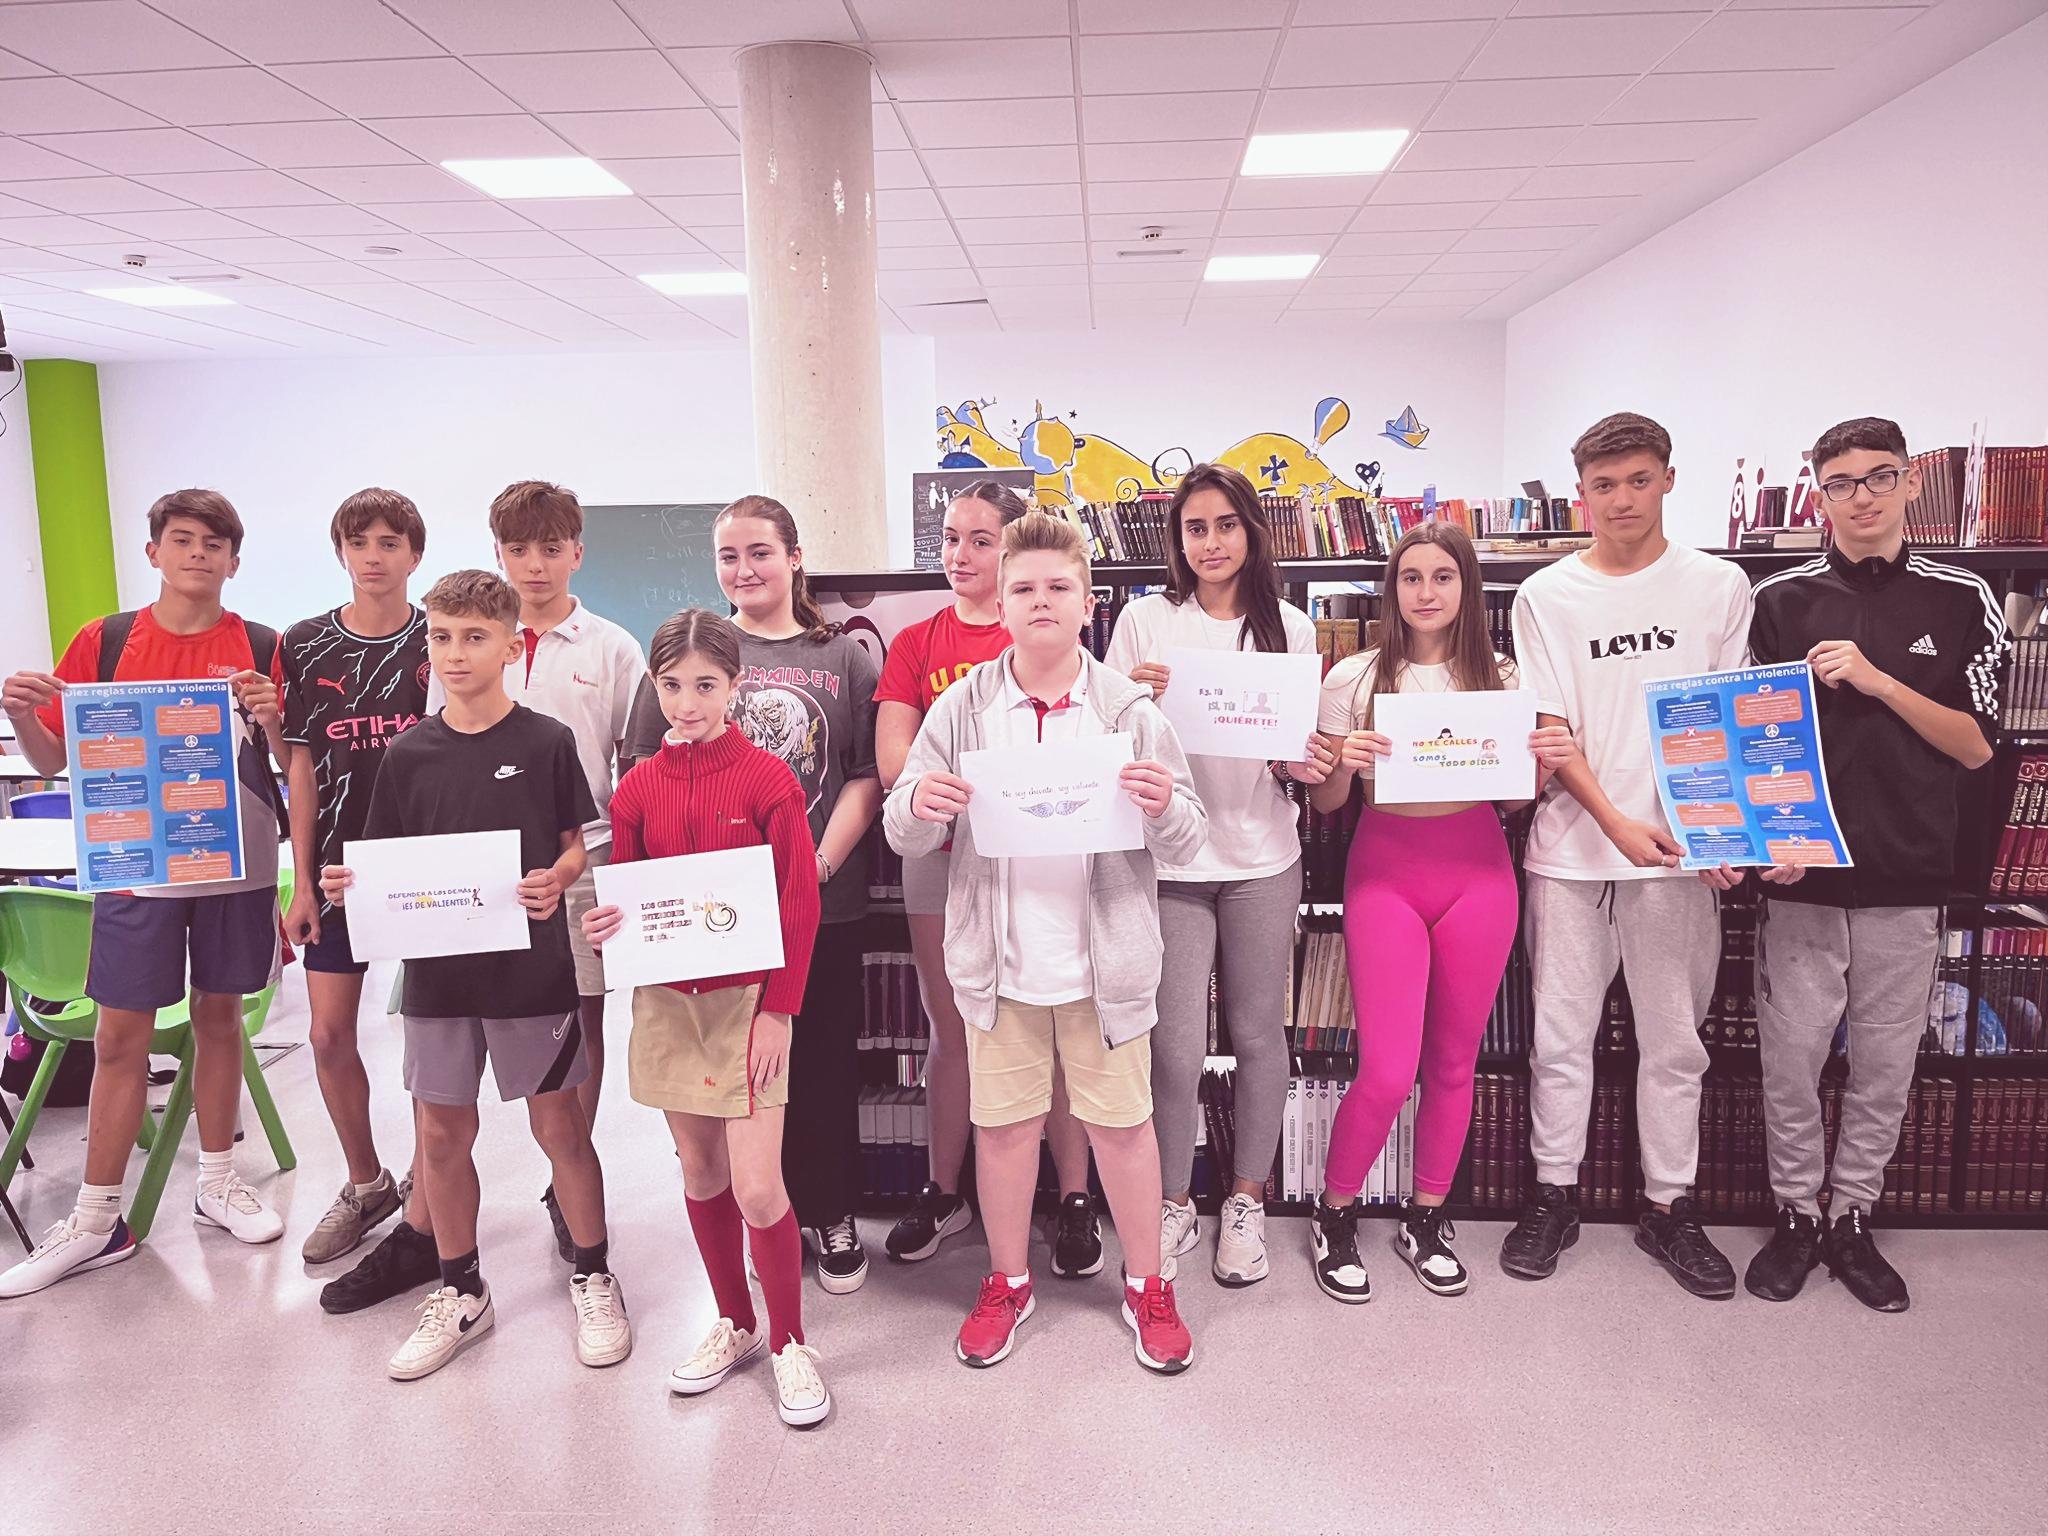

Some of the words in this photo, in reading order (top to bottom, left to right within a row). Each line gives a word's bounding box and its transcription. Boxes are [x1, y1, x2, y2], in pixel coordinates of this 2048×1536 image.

[1731, 480, 1743, 519] 8
[1794, 475, 1811, 516] 7
[1588, 625, 1677, 660] Levi's
[1908, 646, 1938, 656] adidas
[748, 665, 841, 700] MAIDEN
[1646, 683, 1669, 693] Diez
[1671, 679, 1703, 691] reglas
[1705, 674, 1741, 686] contra
[1743, 672, 1754, 681] la
[1756, 665, 1807, 679] violencia
[91, 686, 126, 698] reglas
[127, 686, 164, 695] contra
[166, 684, 177, 693] la
[179, 683, 228, 693] violencia
[325, 712, 420, 740] ETIHA
[350, 736, 393, 752] AIRW
[1412, 740, 1425, 748] NO
[1443, 738, 1478, 747] CALLES
[1412, 754, 1447, 762] SOMOS
[1439, 760, 1467, 768] TODO
[387, 890, 426, 900] DEFENDER
[434, 888, 447, 897] LOS
[415, 900, 425, 909] DE
[426, 897, 471, 908] VALIENTES!
[641, 902, 656, 911] LOS
[657, 898, 685, 909] GRITOS
